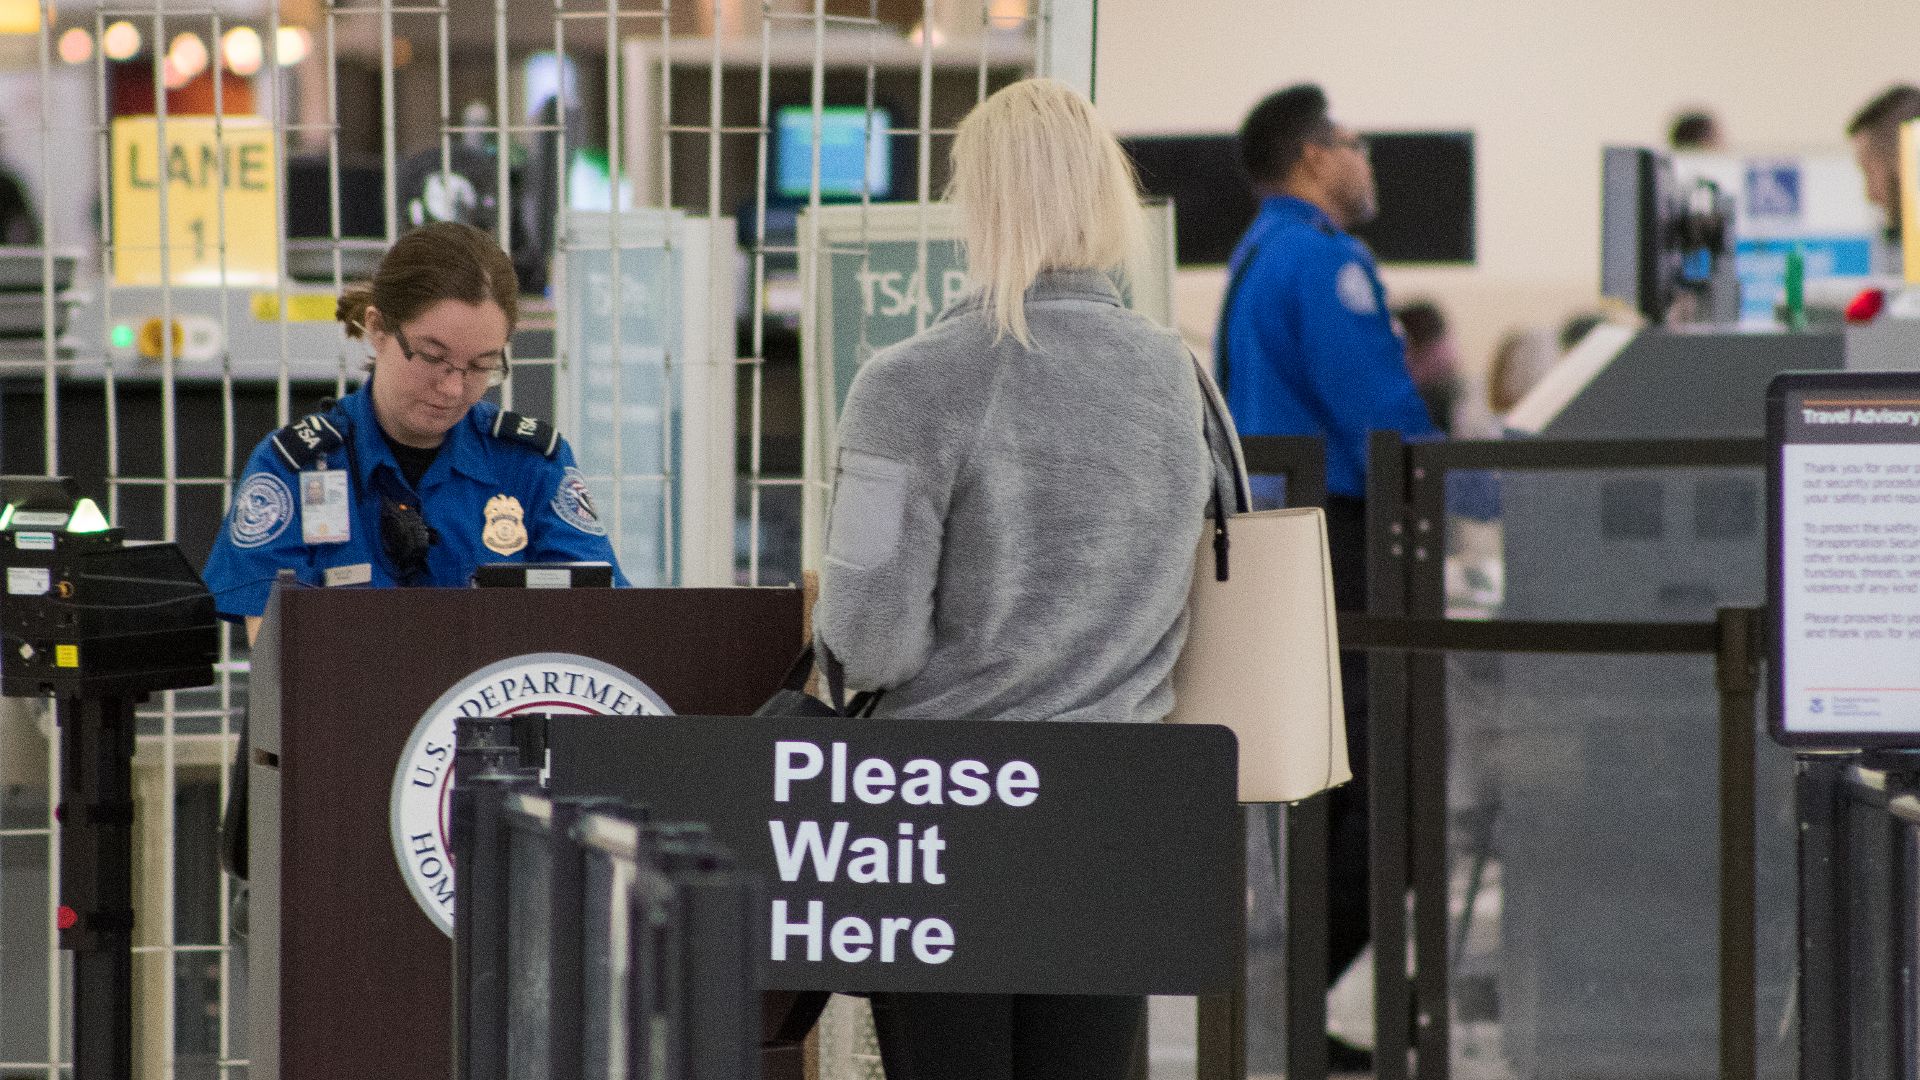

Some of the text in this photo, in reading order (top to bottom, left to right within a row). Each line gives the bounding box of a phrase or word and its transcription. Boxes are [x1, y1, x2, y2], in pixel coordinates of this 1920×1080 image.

[129, 142, 268, 191] LANE
[188, 216, 205, 263] 1
[855, 270, 969, 316] TSA P
[291, 418, 322, 450] TSA
[1802, 407, 1920, 427] Travel Advisory
[1804, 462, 1837, 474] Thank
[1842, 462, 1861, 474] you
[1864, 462, 1881, 474] for
[412, 741, 453, 790] U.S.
[774, 740, 1040, 807] Please
[411, 832, 455, 917] HOM
[768, 820, 946, 885] Wait
[771, 899, 955, 965] Here
